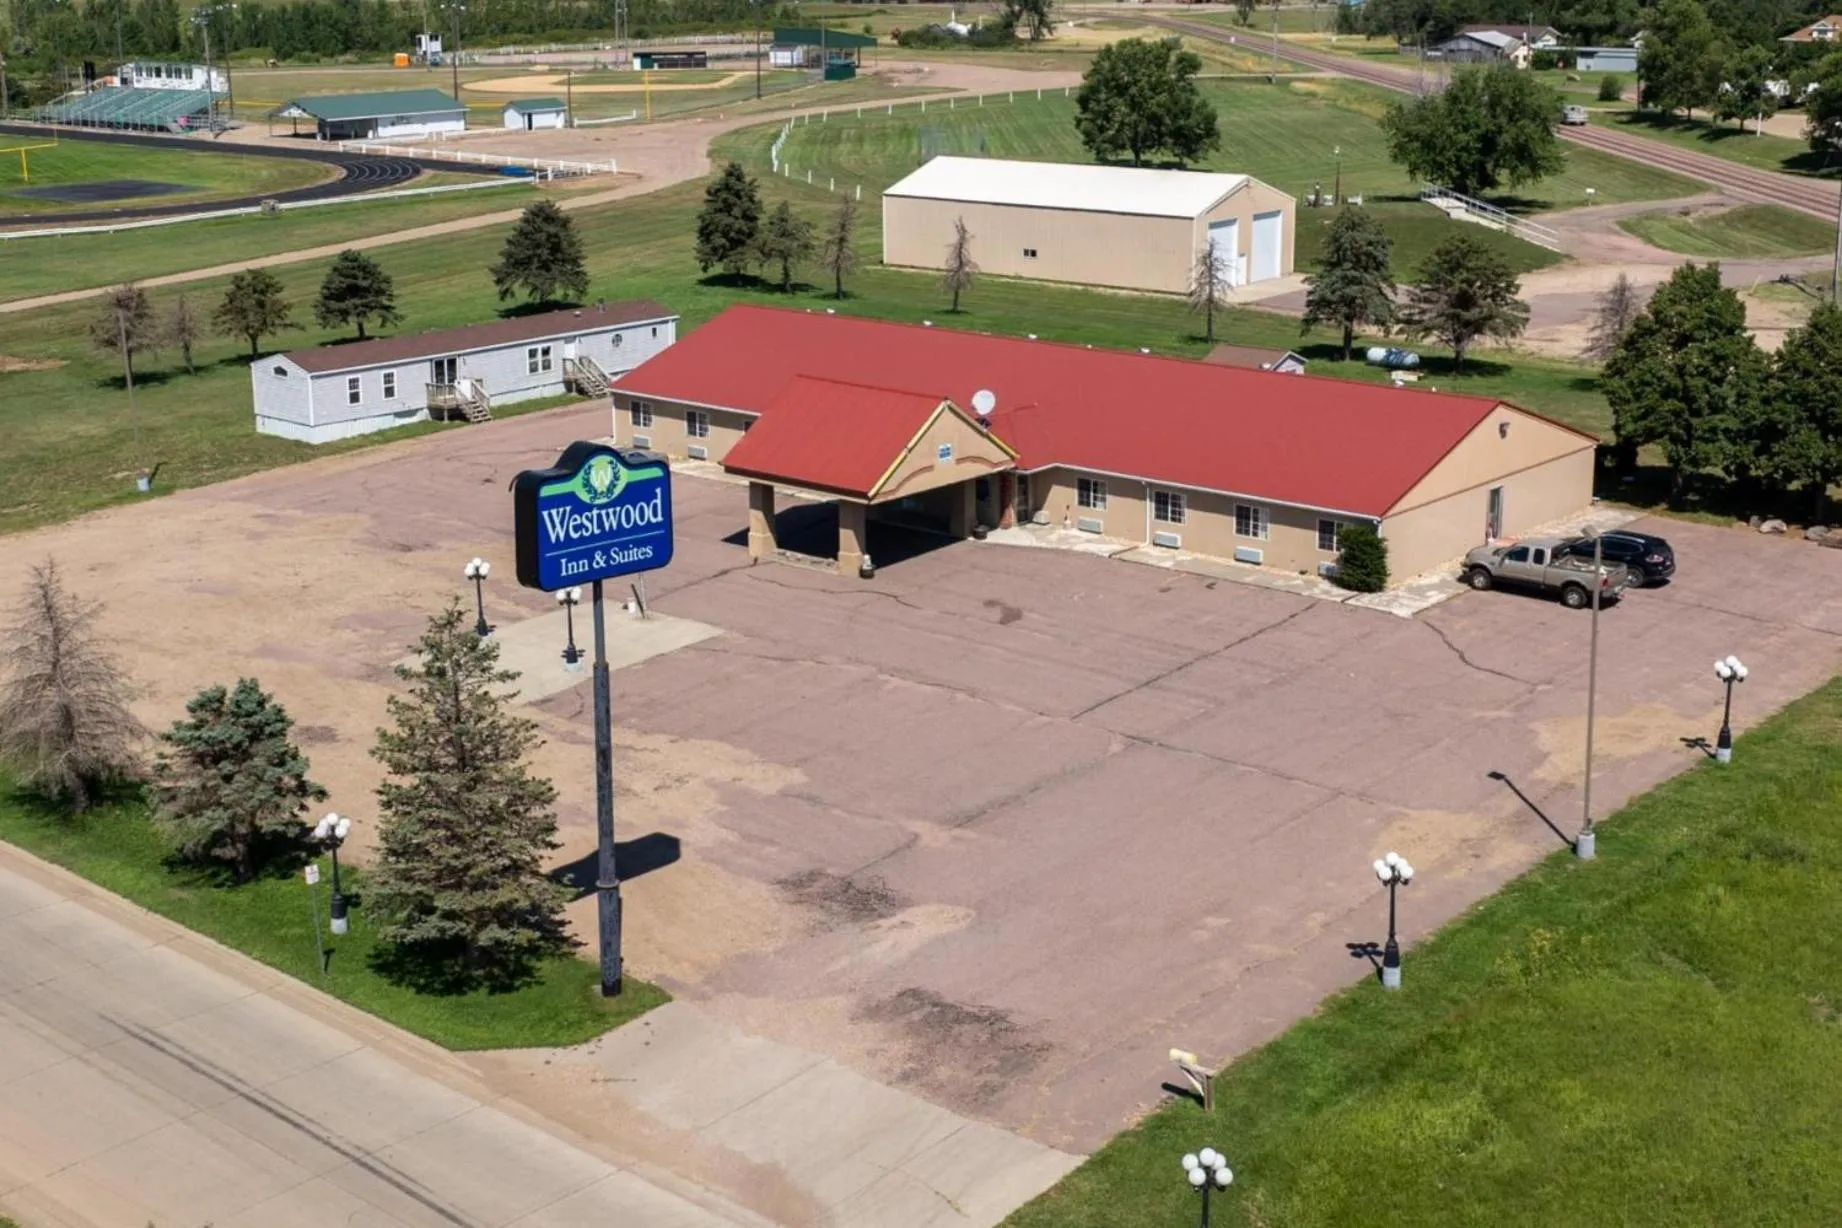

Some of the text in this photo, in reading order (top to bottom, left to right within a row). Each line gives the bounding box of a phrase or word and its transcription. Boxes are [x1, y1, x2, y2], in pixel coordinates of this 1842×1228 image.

[542, 487, 664, 544] Westwood
[560, 545, 653, 576] Inn & Suites
